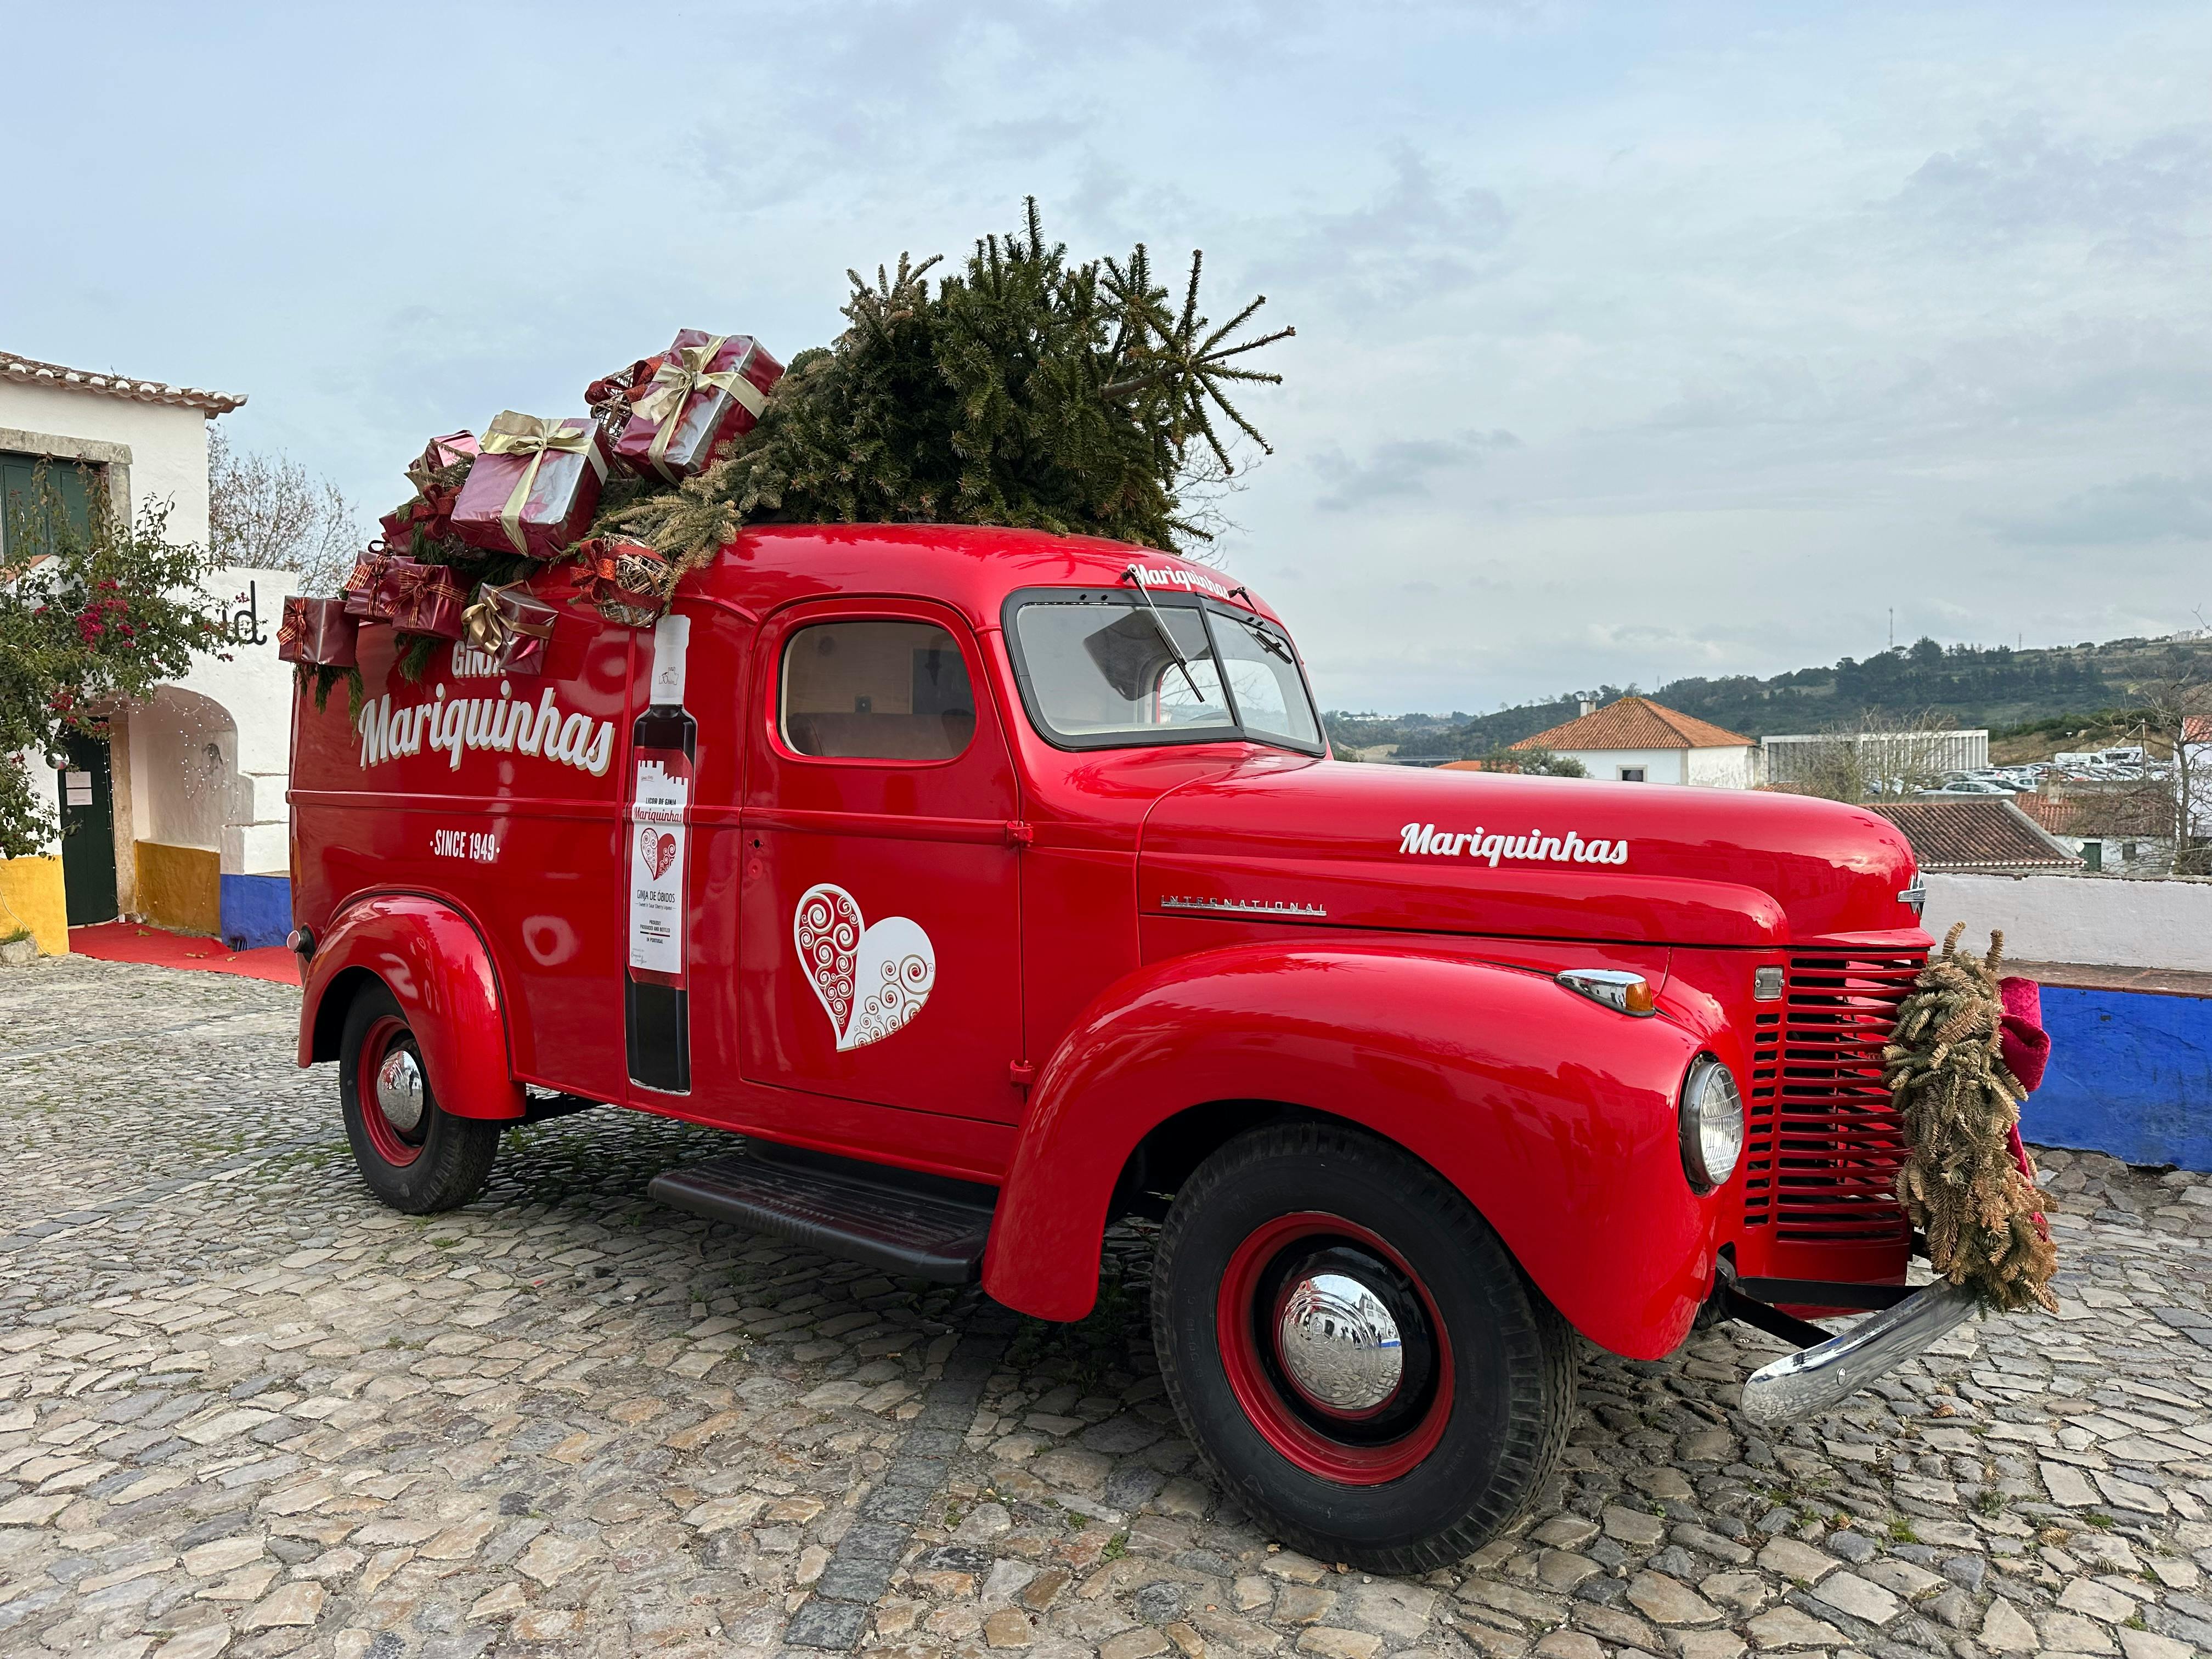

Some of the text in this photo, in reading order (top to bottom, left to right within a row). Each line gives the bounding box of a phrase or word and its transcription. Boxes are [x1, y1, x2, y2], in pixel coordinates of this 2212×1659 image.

[358, 680, 614, 776] Mariquinhas
[634, 807, 682, 824] Mariquinhas
[1399, 823, 1628, 868] Mariquinhas
[637, 889, 675, 903] GINJA DE ÓBIDOS
[1161, 895, 1325, 913] INTERNATIONAL
